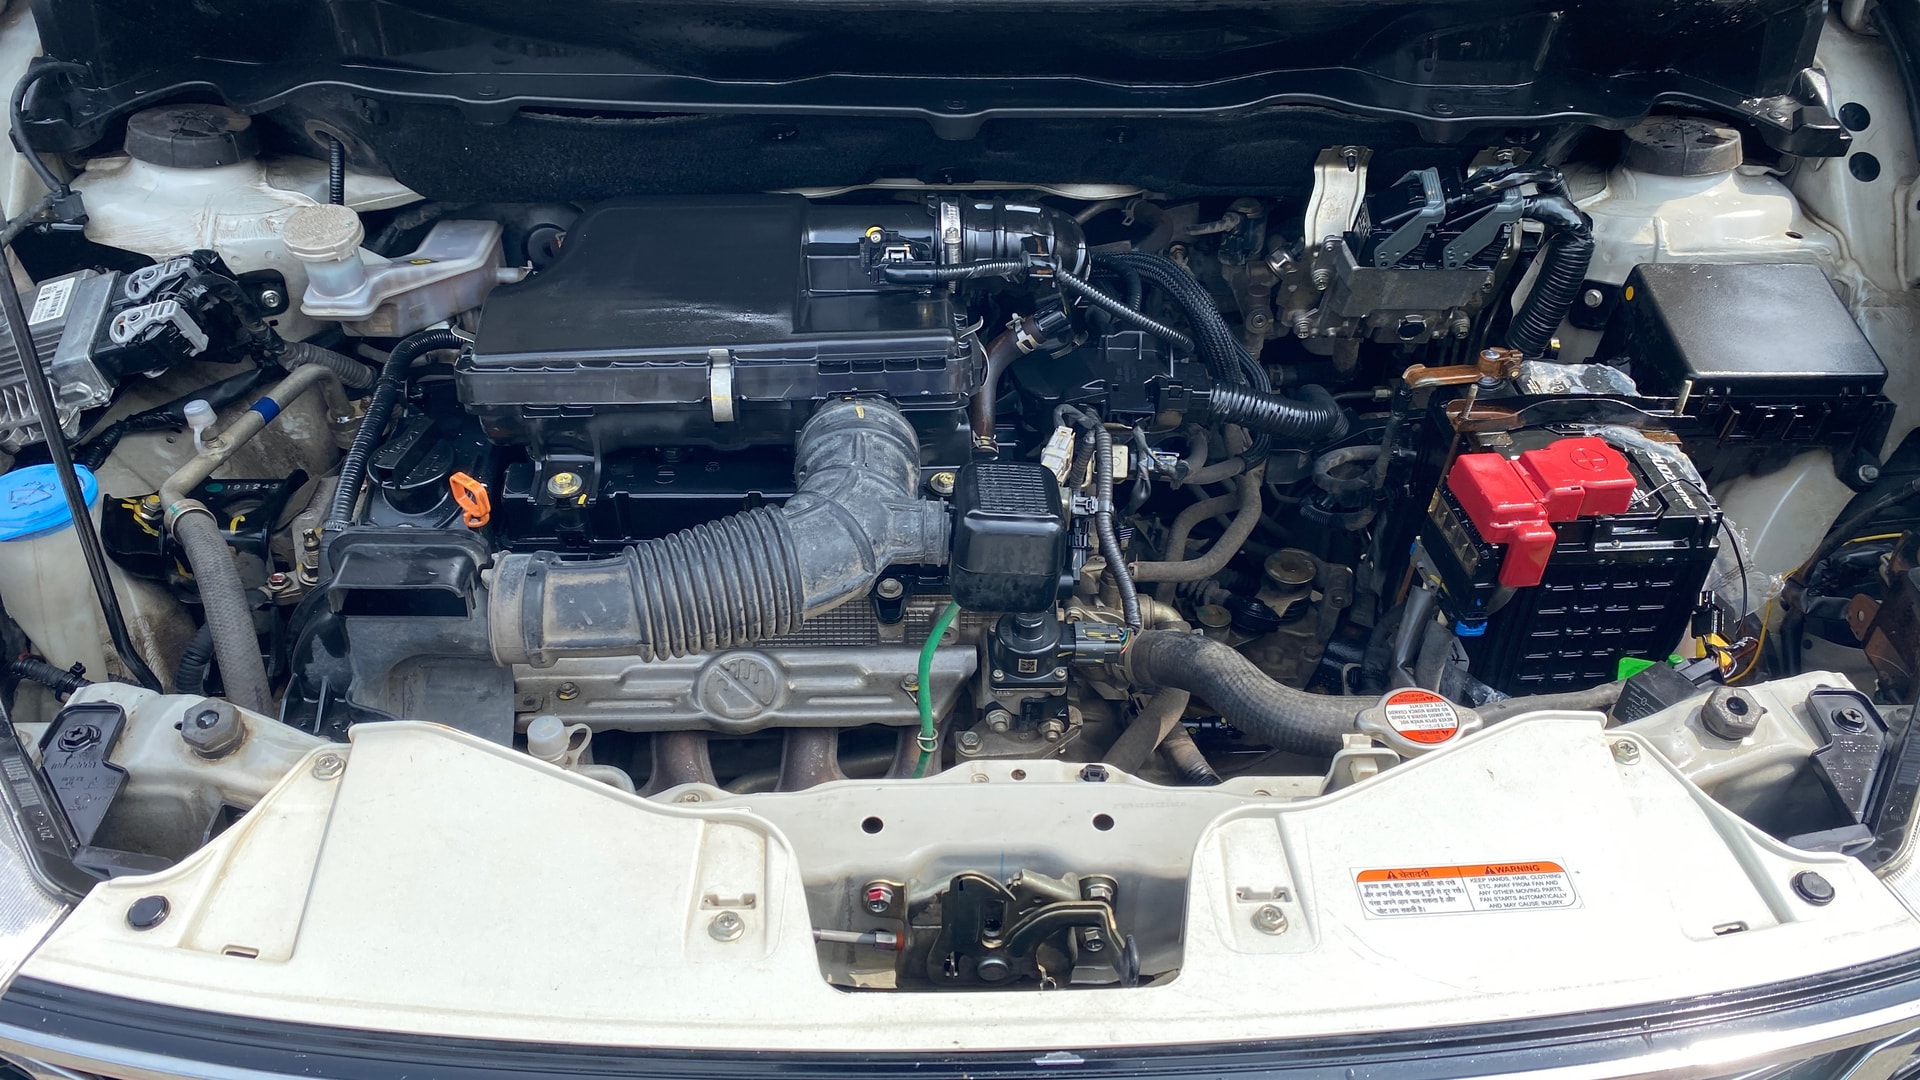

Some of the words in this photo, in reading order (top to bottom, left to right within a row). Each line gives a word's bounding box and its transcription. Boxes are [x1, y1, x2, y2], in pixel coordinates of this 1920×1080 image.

[1398, 868, 1430, 878] चेतावनी
[1494, 864, 1540, 873] WARNING
[1518, 892, 1567, 901] AUTOMATICALLY
